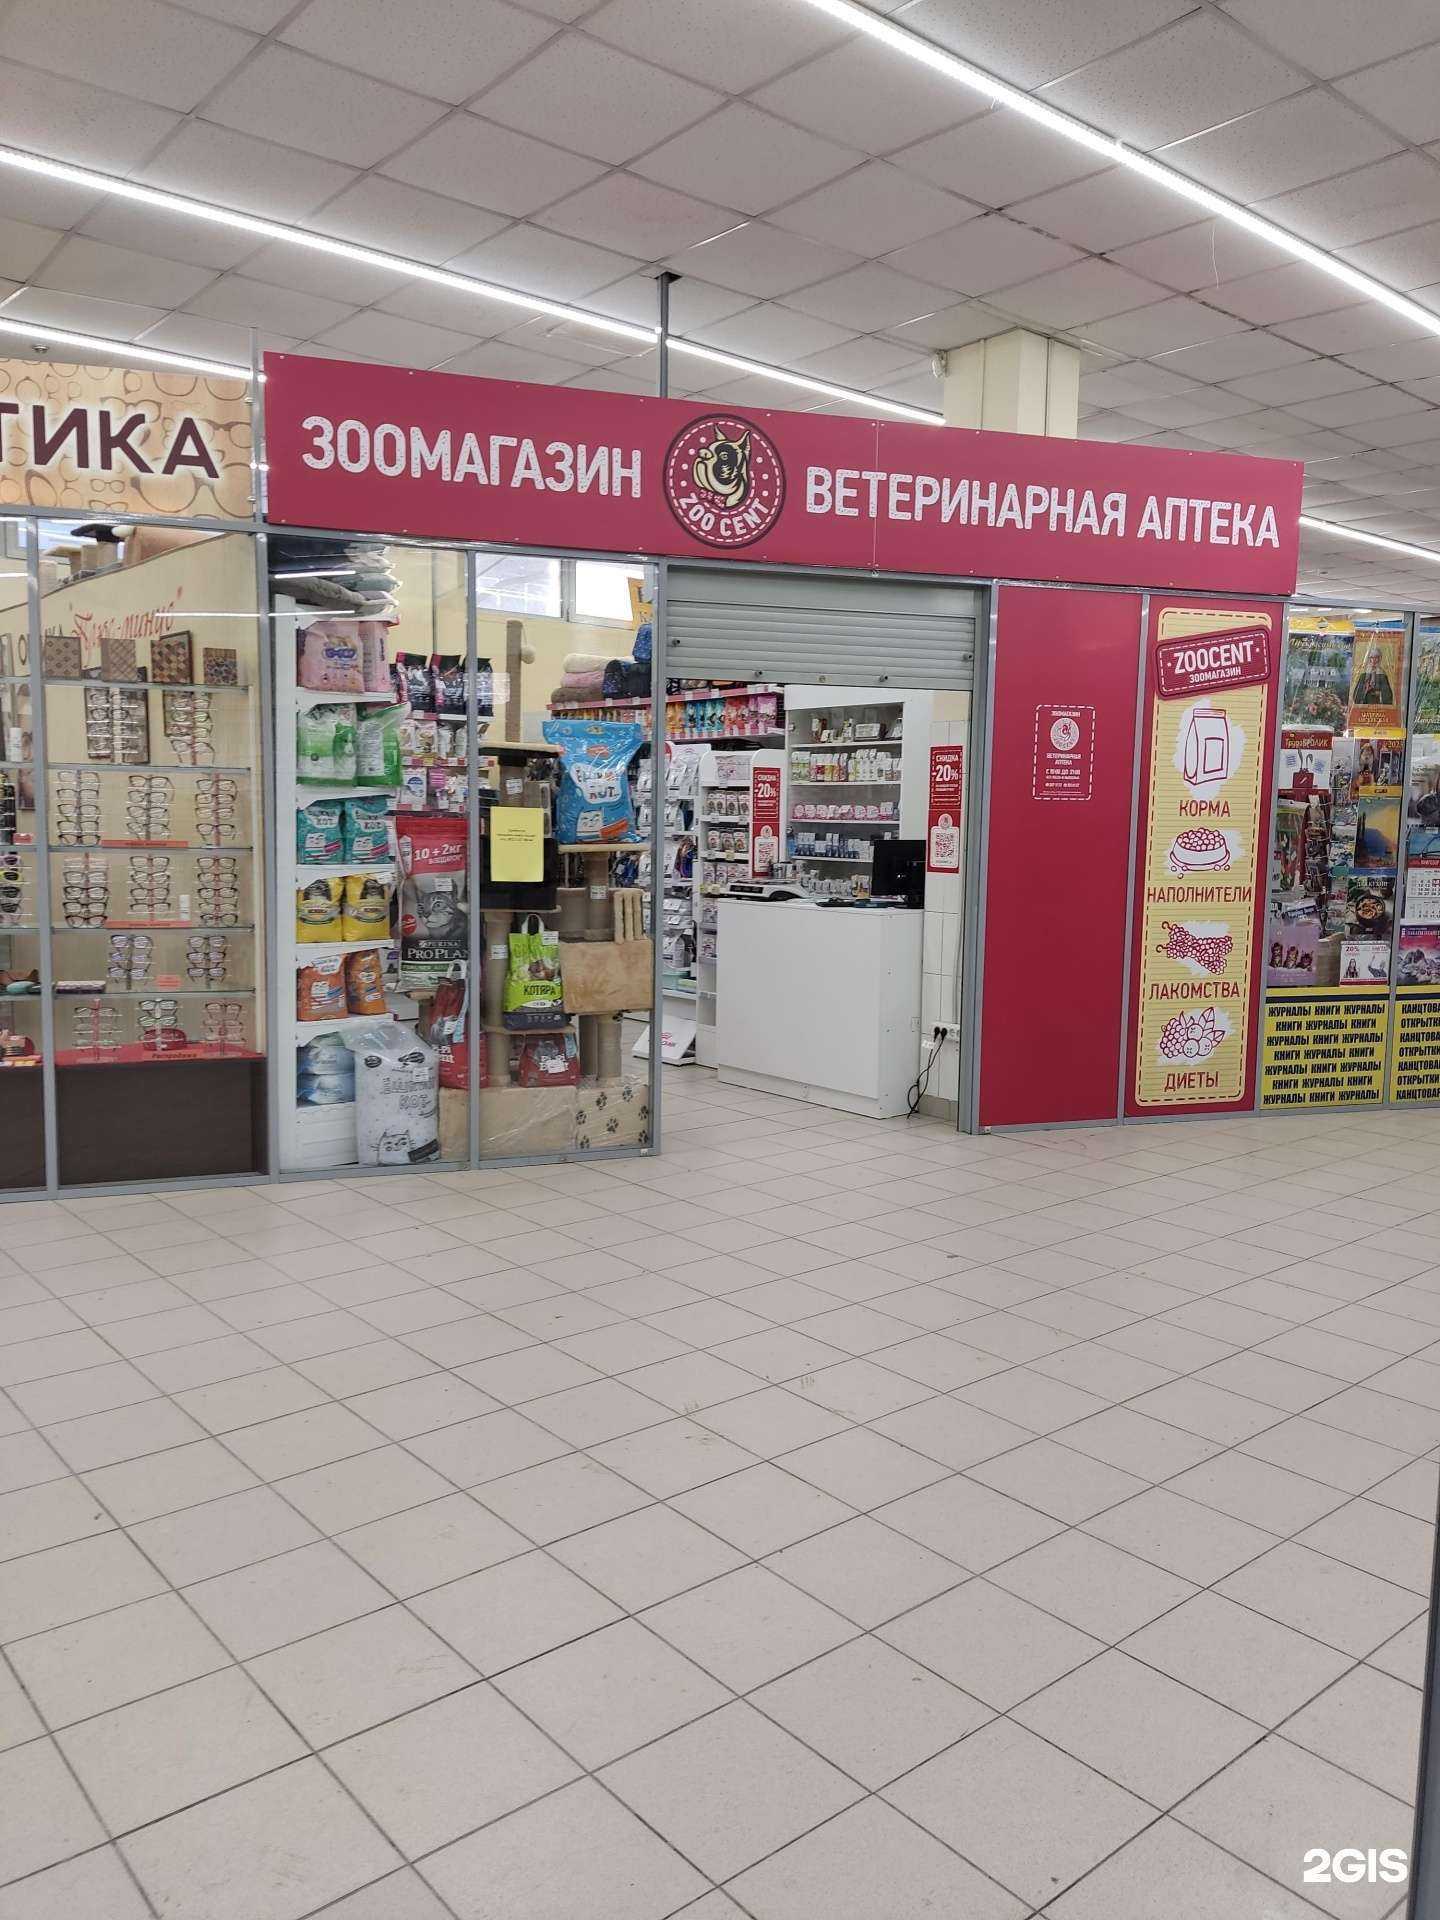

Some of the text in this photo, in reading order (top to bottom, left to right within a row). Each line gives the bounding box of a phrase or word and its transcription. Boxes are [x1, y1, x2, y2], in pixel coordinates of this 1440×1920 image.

[301, 416, 642, 498] ЗООМАГАЗИН
[679, 492, 769, 537] ZOO CENT
[806, 466, 1280, 549] ВЕТЕРИНАРНАЯ АПТЕКА
[1173, 640, 1254, 674] ZOOCENT
[1189, 666, 1241, 683] ЗООМАГАЗИН
[935, 754, 959, 763] СКИДКА
[1179, 799, 1231, 818] КОРМА
[413, 847, 430, 861] 10
[1147, 885, 1253, 904] НАПОЛНИТЕЛИ
[407, 947, 434, 959] PRO
[1149, 981, 1240, 1000] ЛАКОМСТВА
[1268, 1004, 1385, 1017] ЖУРНАЛЫ КНИГИ ЖУРНАЛЫ
[1276, 1018, 1376, 1031] КНИГИ ЖУРНАЛЫ КНИГИ
[1266, 1033, 1383, 1046] ЖУРНАЛЫ КНИГИ ЖУРНАЛЫ
[1274, 1047, 1374, 1060] КНИГИ ЖУРНАЛЫ КНИГИ
[1265, 1061, 1381, 1075] ЖУРНАЛЫ КНИГИ ЖУРНАЛЫ
[1398, 1060, 1440, 1071] КАНЦТОВА
[1164, 1071, 1219, 1092] ДИЕТЫ
[1272, 1076, 1372, 1090] КНИГИ ЖУРНАЛЫ КНИГИ
[1397, 1074, 1440, 1086] ОТКРЫТКИ
[1263, 1090, 1379, 1104] ЖУРНАЛЫ КНИГИ ЖУРНАЛЫ
